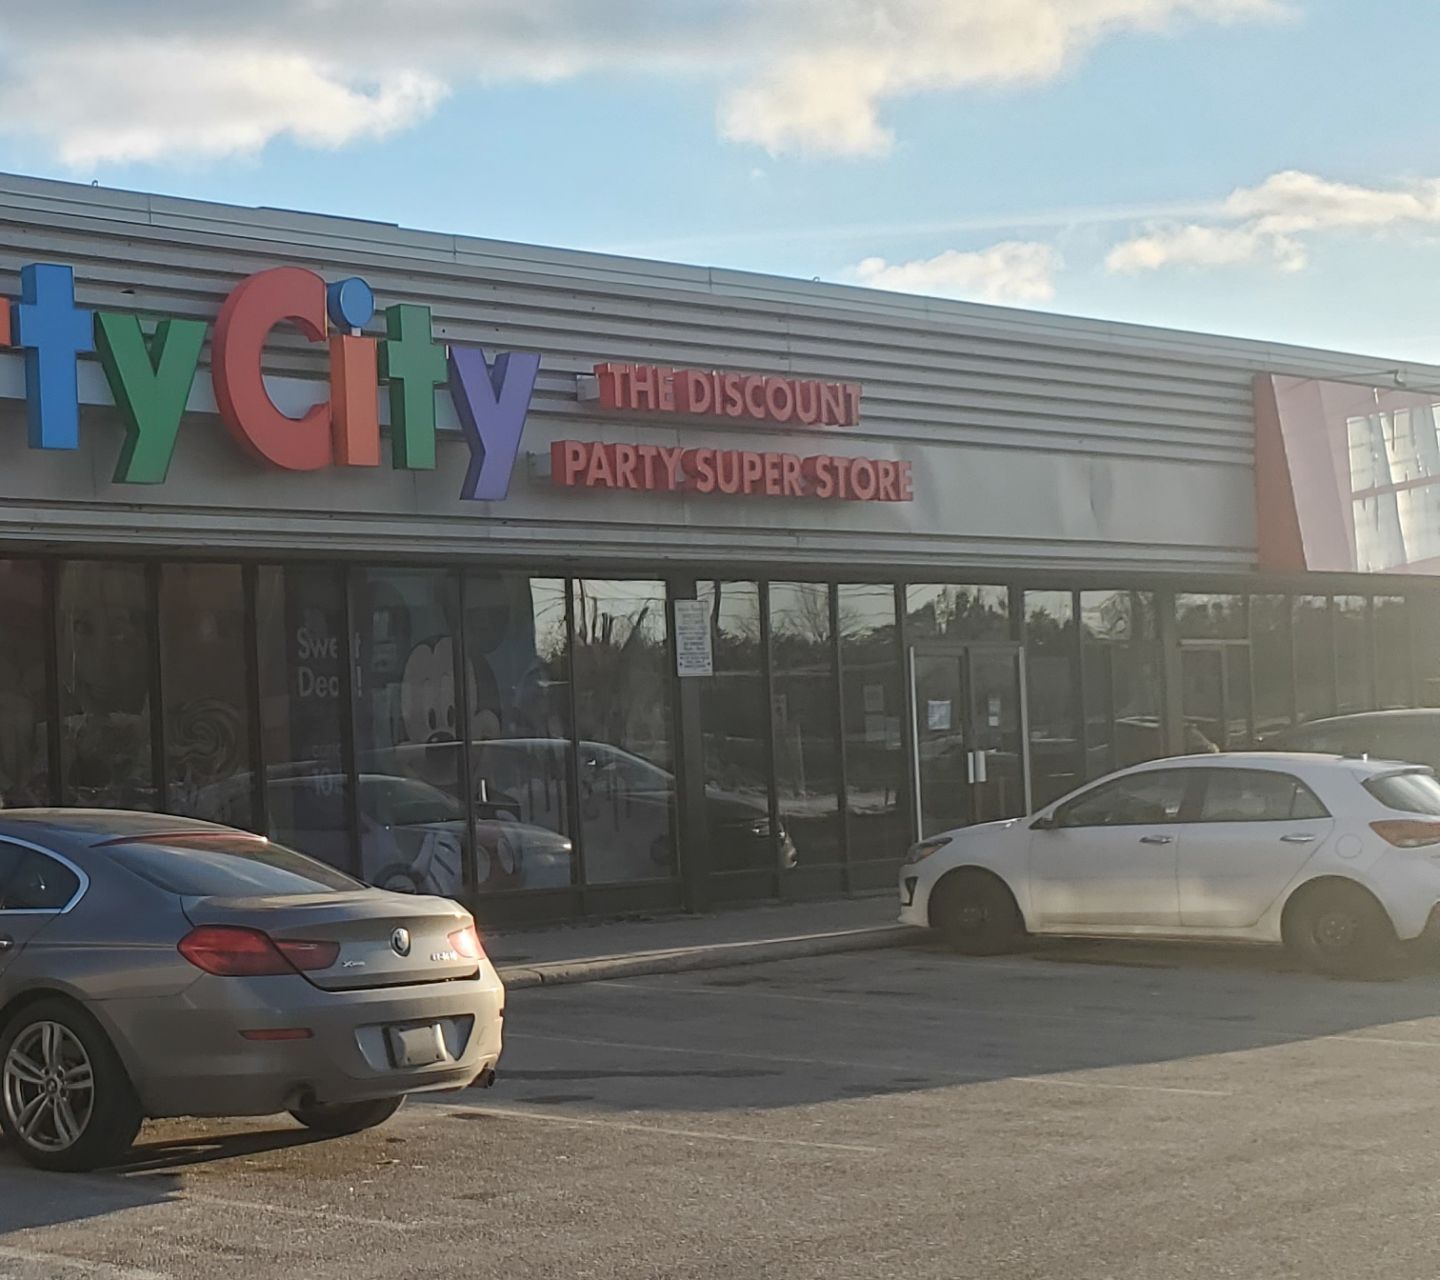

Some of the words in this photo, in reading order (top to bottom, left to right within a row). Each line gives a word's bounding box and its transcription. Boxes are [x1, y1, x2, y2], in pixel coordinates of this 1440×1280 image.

[211, 266, 542, 502] City
[600, 363, 675, 411] THE
[680, 369, 863, 426] DISCOUNT
[554, 440, 683, 491] PARTY
[688, 447, 803, 496] SUPER
[810, 454, 913, 502] STORE
